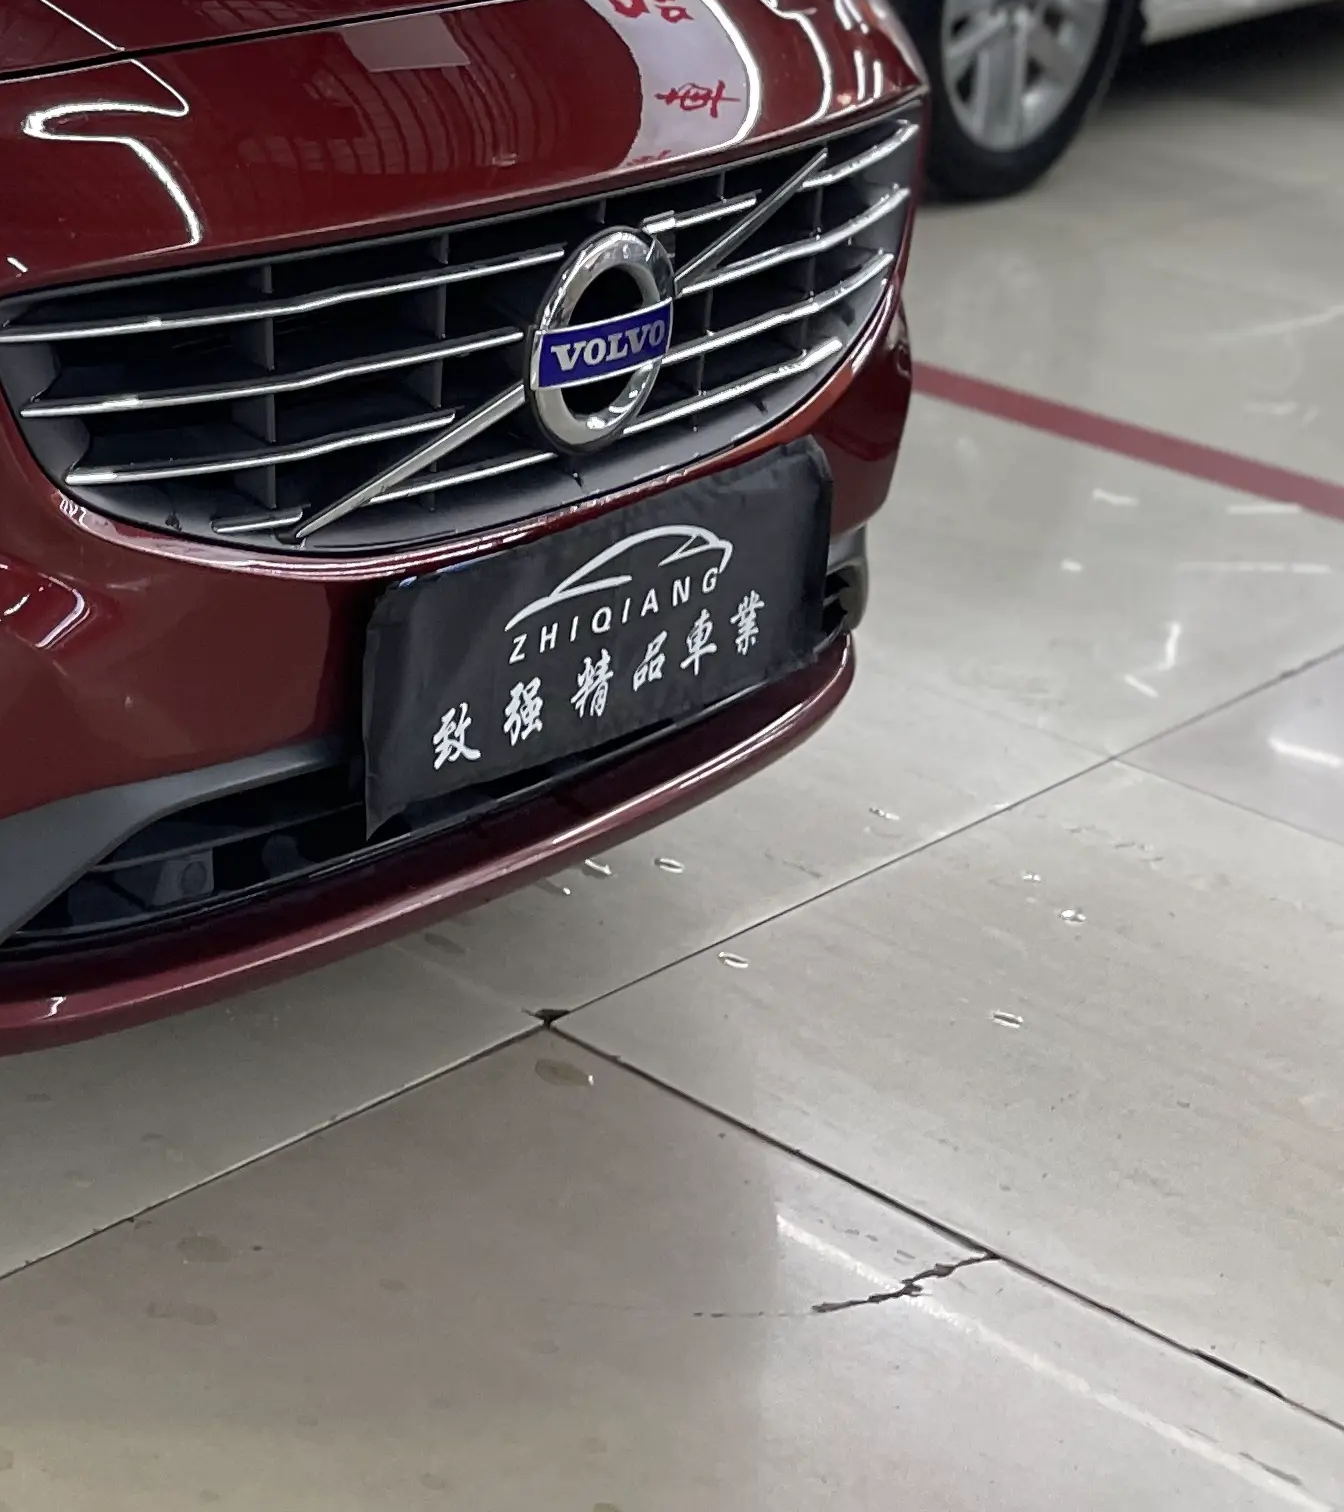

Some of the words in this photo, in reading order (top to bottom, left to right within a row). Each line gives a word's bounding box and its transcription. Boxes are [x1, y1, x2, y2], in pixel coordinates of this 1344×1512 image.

[550, 319, 666, 372] VOLVO
[509, 566, 719, 665] ZHIQIANG
[432, 589, 766, 771] 致强精品車業
